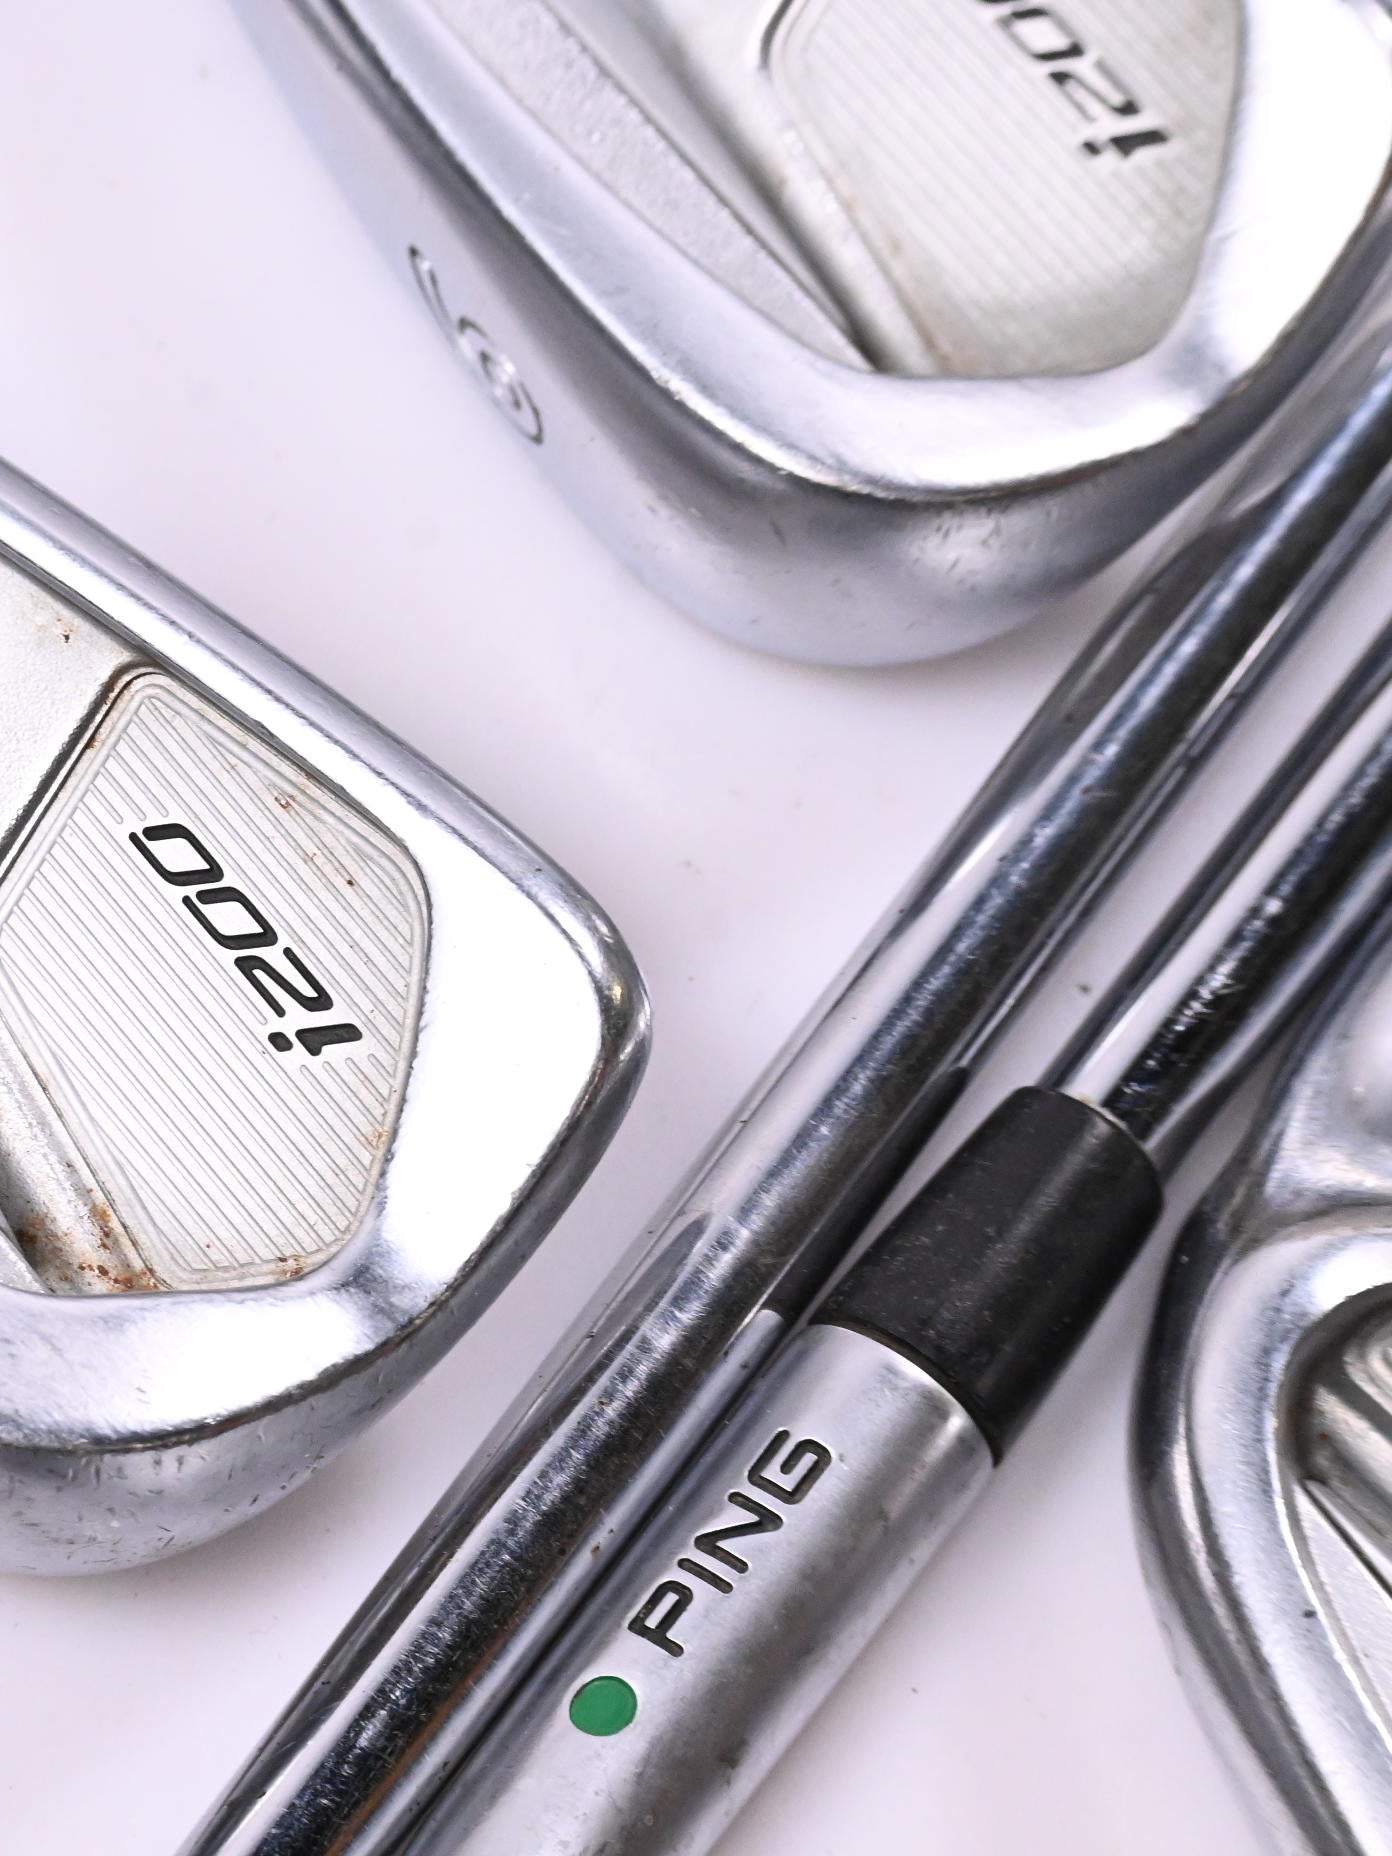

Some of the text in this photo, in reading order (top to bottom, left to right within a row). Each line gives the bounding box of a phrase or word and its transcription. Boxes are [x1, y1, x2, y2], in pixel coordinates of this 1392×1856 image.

[982, 0, 1169, 158] i20
[128, 822, 363, 1057] i200
[627, 1429, 833, 1657] PING
